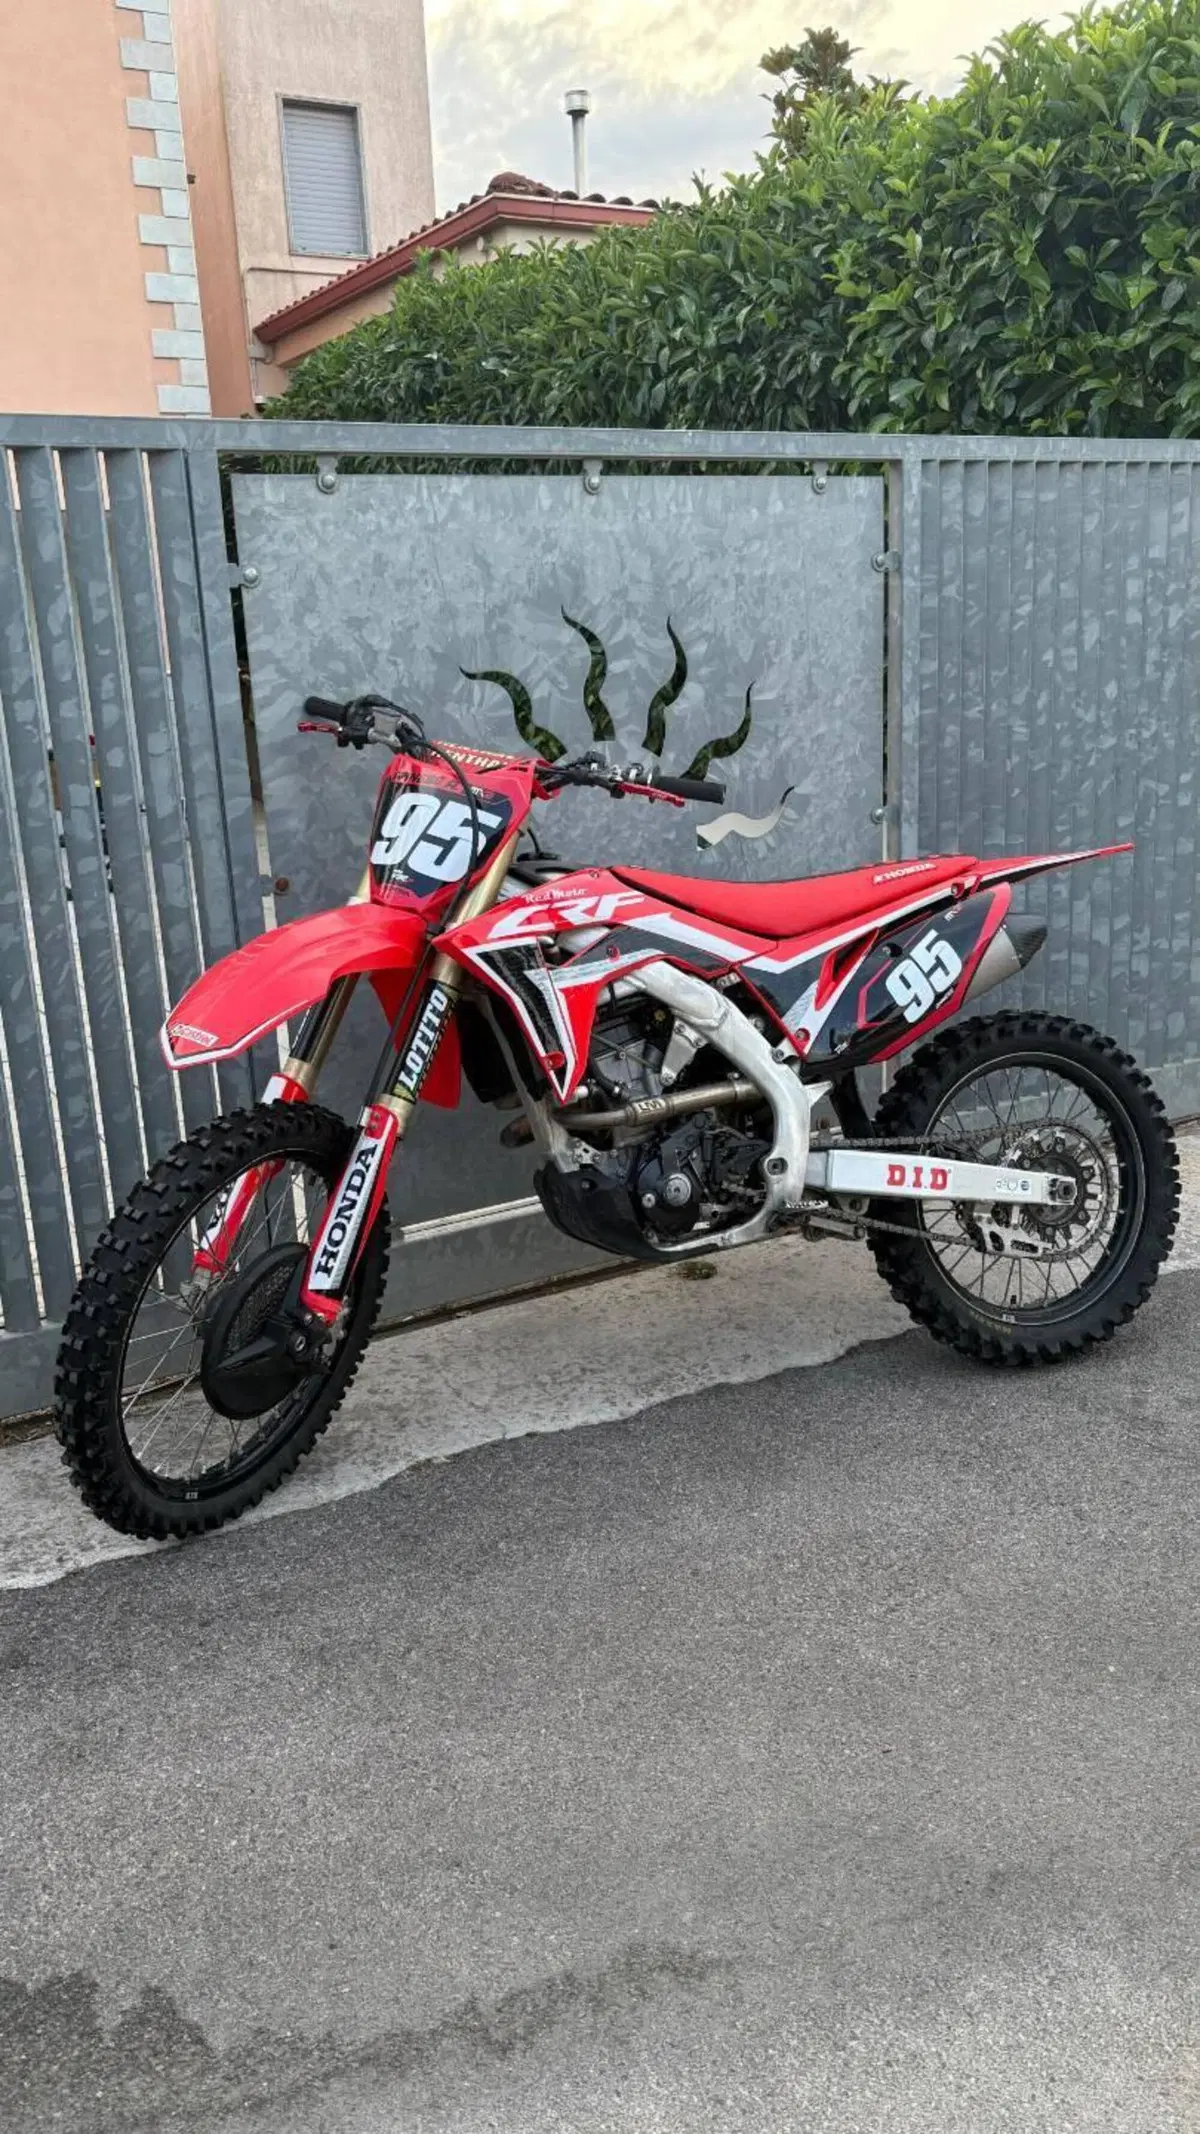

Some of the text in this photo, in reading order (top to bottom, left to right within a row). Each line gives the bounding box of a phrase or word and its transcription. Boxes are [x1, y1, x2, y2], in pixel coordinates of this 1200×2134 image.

[370, 792, 502, 882] 95
[486, 891, 645, 939] CRF
[885, 929, 962, 1023] 95
[399, 988, 448, 1091] LOTITO
[315, 1143, 377, 1279] HONDA
[887, 1164, 948, 1190] D.I.D
